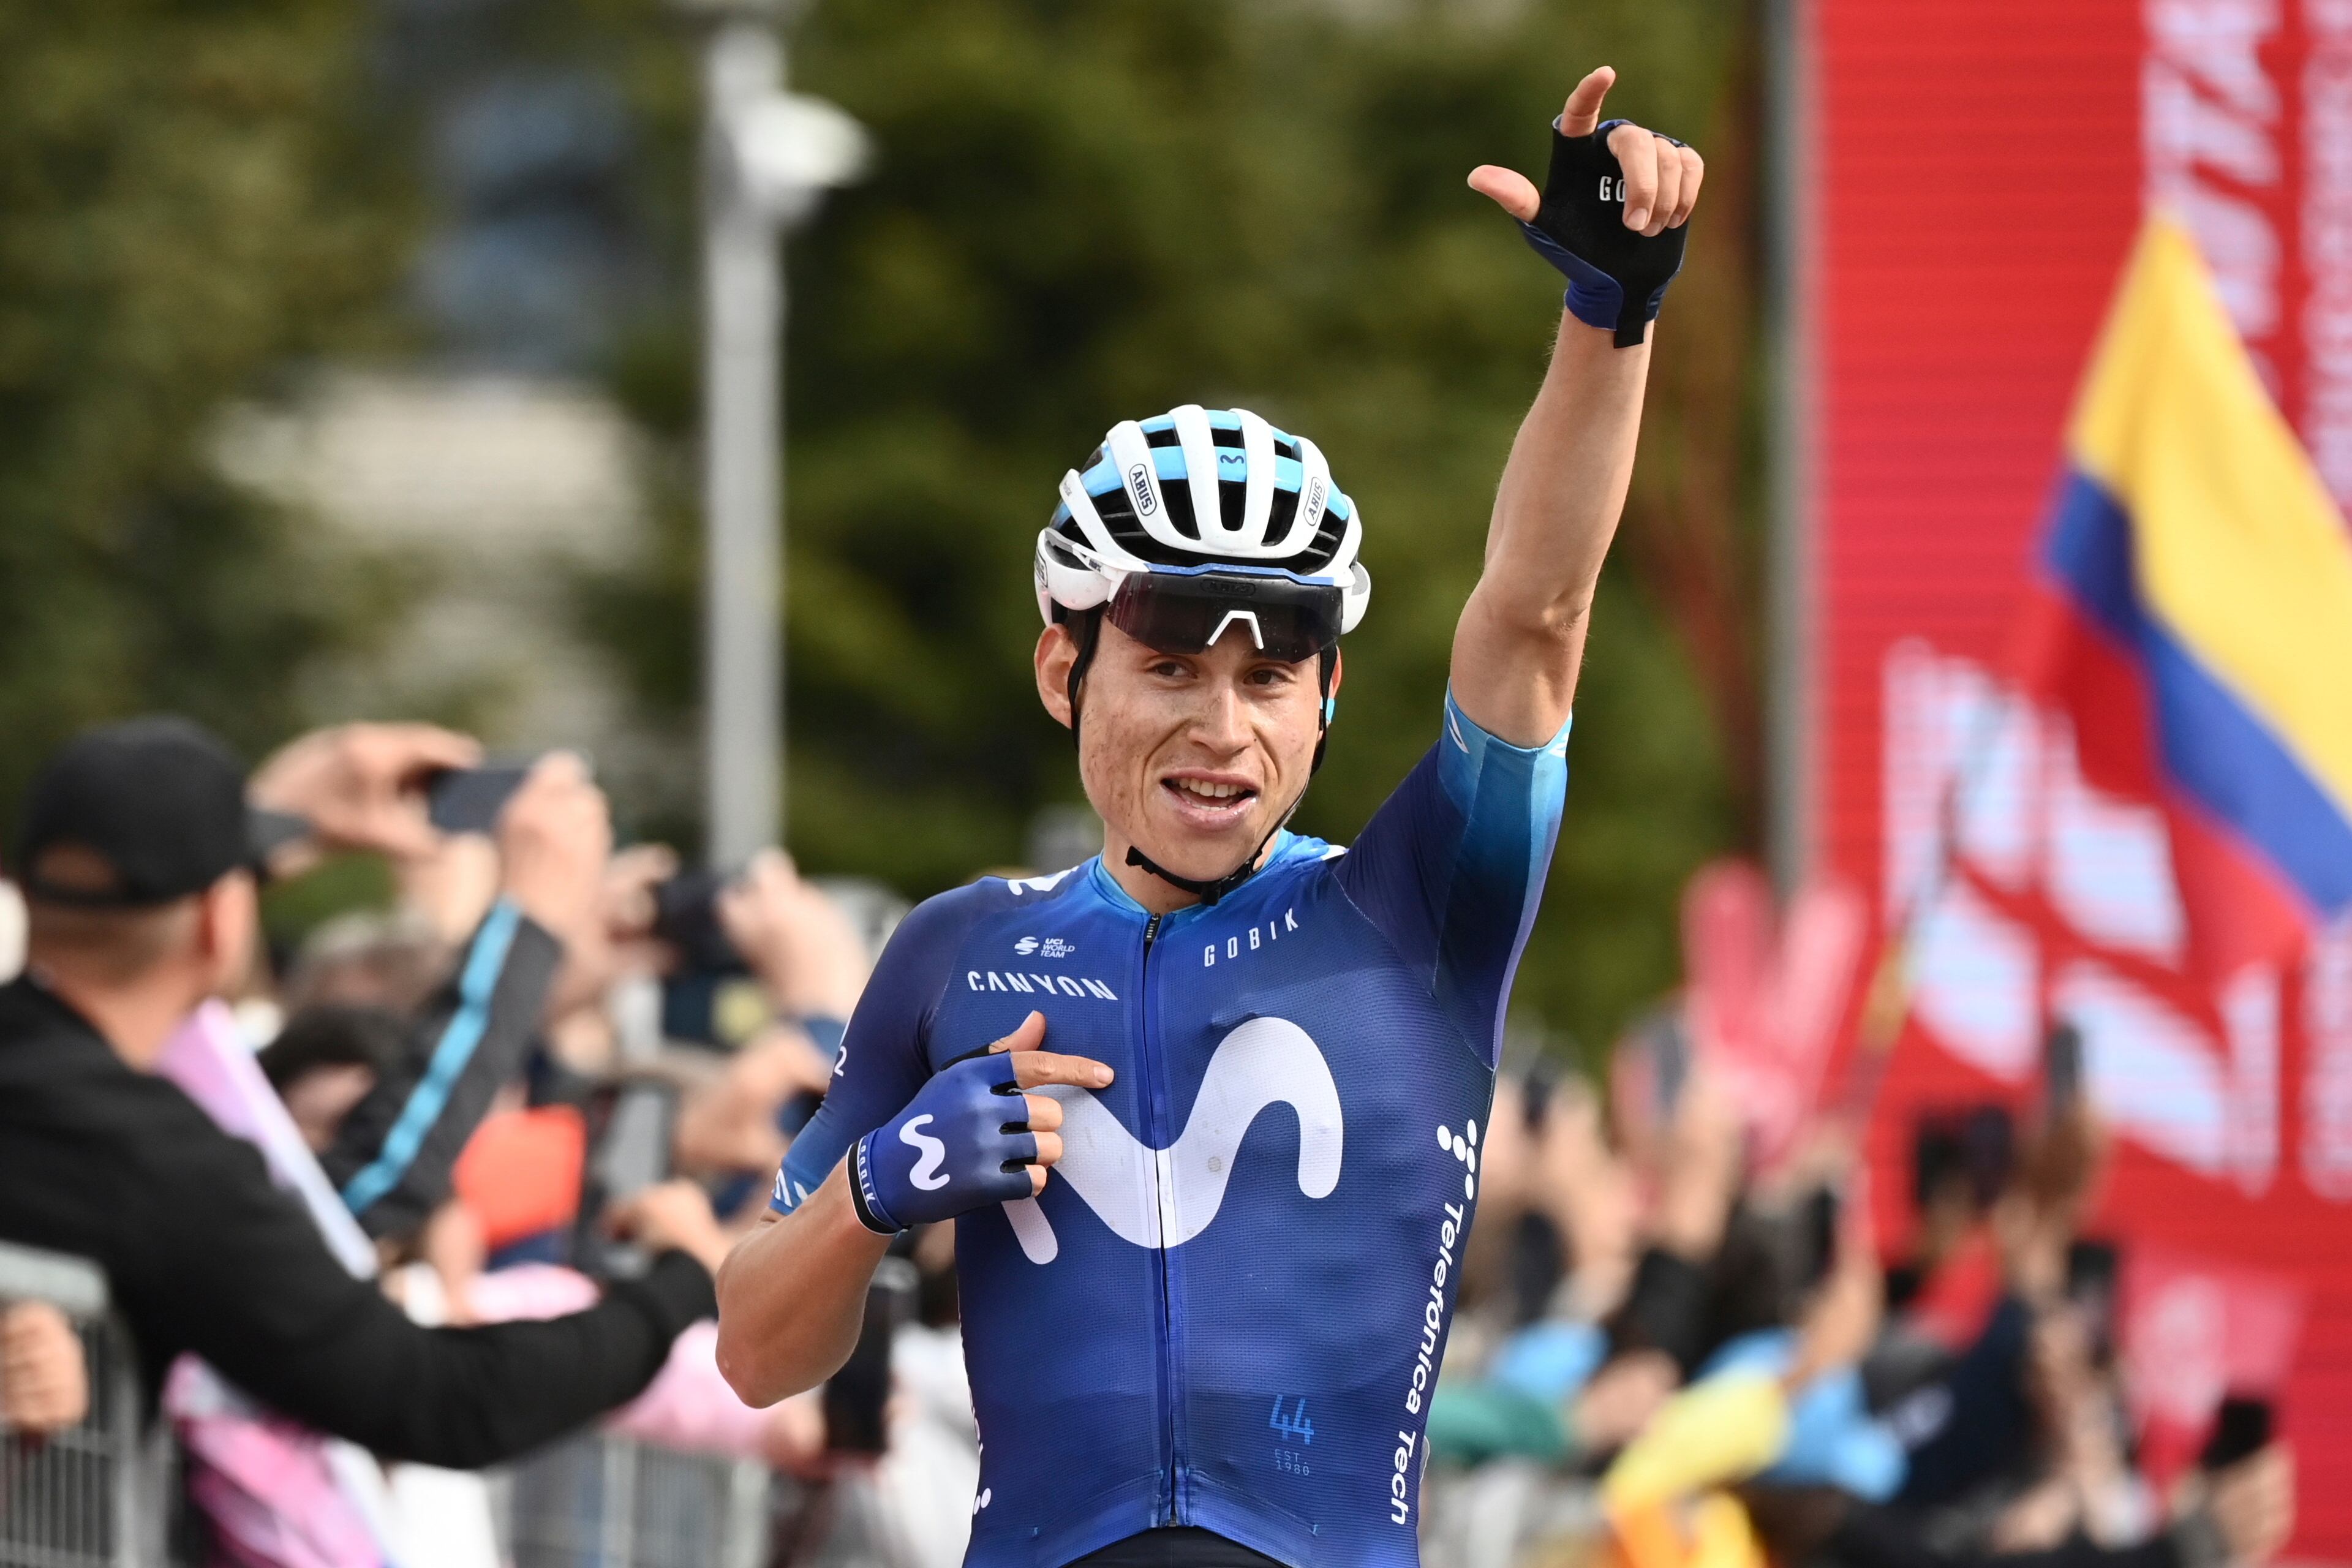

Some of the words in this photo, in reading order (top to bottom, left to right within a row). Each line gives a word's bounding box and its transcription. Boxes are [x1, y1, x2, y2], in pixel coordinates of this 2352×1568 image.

[1599, 176, 1626, 202] GO
[1132, 470, 1153, 510] ABUS
[1308, 481, 1322, 521] ABUS
[1042, 944, 1076, 952] WORLD
[1204, 908, 1298, 967] GOBIK
[967, 970, 1119, 1001] CANYON
[1406, 1202, 1464, 1415] Telefónica
[1270, 1394, 1314, 1445] 44
[1276, 1460, 1310, 1476] 1980
[1391, 1431, 1416, 1525] Tech
